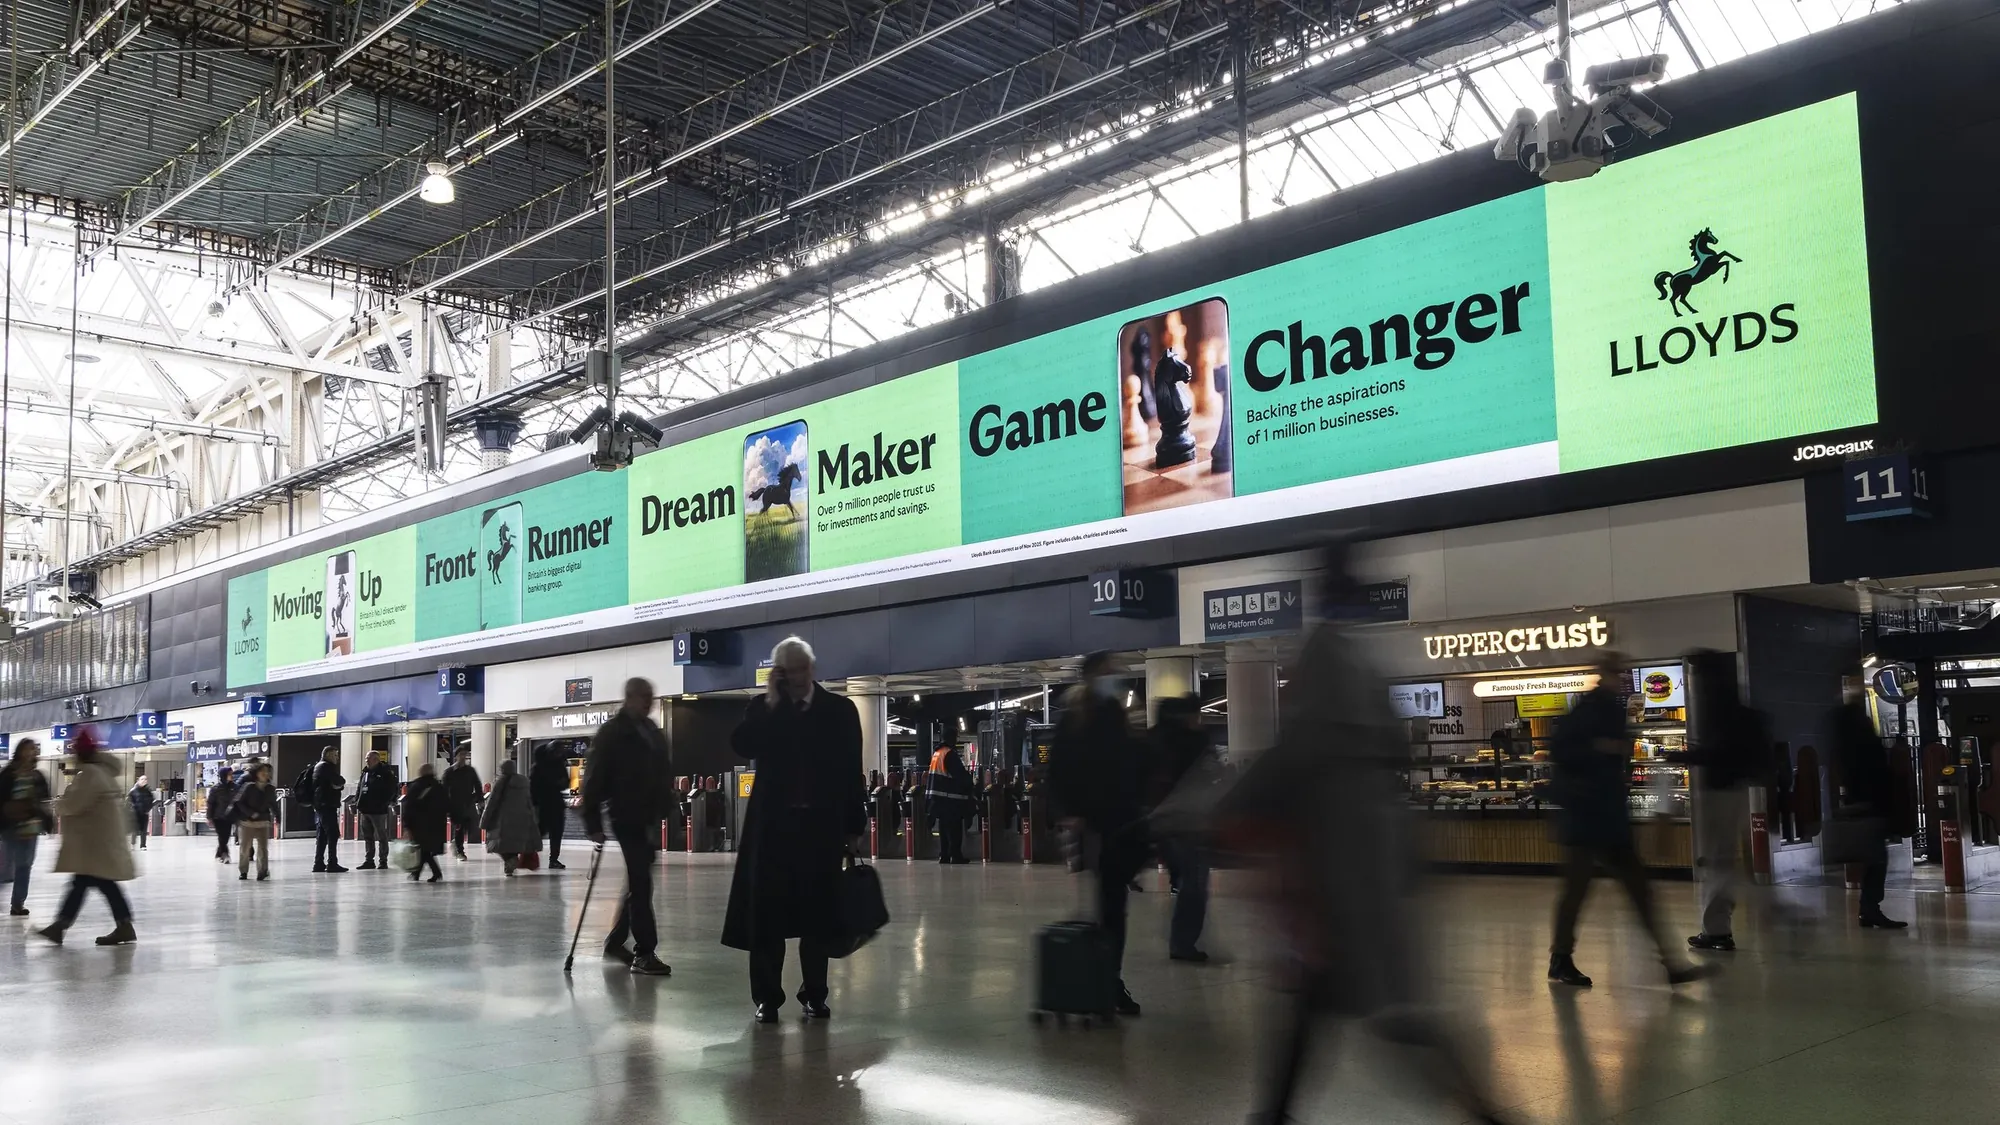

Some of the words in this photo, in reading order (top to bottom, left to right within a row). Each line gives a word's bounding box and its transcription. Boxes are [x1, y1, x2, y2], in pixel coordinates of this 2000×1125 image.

[1243, 281, 1530, 392] Changer
[1610, 303, 1798, 377] LLOYDS
[1247, 400, 1297, 423] Backing
[1300, 396, 1323, 412] the
[1327, 378, 1406, 405] aspirations
[969, 392, 1106, 457] Game
[1247, 431, 1261, 445] of
[1264, 429, 1268, 441] 1
[1272, 419, 1316, 441] million
[1320, 405, 1399, 430] businesses.
[1793, 439, 1874, 462] JCDecaux
[817, 432, 936, 495] Maker
[1853, 467, 1902, 502] 11
[1912, 467, 1928, 500] 11
[642, 484, 735, 536] Dream
[817, 503, 837, 517] Over
[838, 502, 843, 513] 9
[845, 497, 871, 511] million
[873, 490, 901, 506] people
[902, 486, 924, 498] trust
[925, 484, 935, 494] us
[817, 521, 828, 532] for
[830, 513, 877, 530] investments
[880, 509, 896, 520] and
[898, 502, 930, 519] savings.
[528, 516, 612, 563] Runner
[1043, 539, 1054, 547] Figure
[425, 546, 476, 586] Front
[528, 569, 546, 580] Britain's
[548, 565, 565, 577] biggest
[566, 560, 582, 574] digital
[360, 570, 382, 606] Up
[528, 583, 546, 594] banking
[548, 581, 563, 591] group.
[1093, 578, 1116, 603] 10
[1124, 579, 1144, 601] 10
[1381, 588, 1406, 600] WiFi
[273, 586, 323, 622] Moving
[1209, 621, 1226, 631] Wide
[1227, 619, 1257, 630] Platform
[1258, 617, 1274, 627] Gate
[235, 637, 259, 655] LLOYDS
[678, 640, 685, 656] 9
[699, 639, 708, 655] 9
[441, 674, 446, 686] 8
[457, 673, 466, 686] 8
[1492, 682, 1525, 692] Famously
[1526, 681, 1546, 690] Fresh
[1548, 679, 1584, 690] Baguettes
[257, 700, 266, 711] 7
[1445, 705, 1462, 717] ess
[148, 716, 156, 725] 6
[1429, 720, 1464, 735] runch
[60, 728, 67, 737] 5
